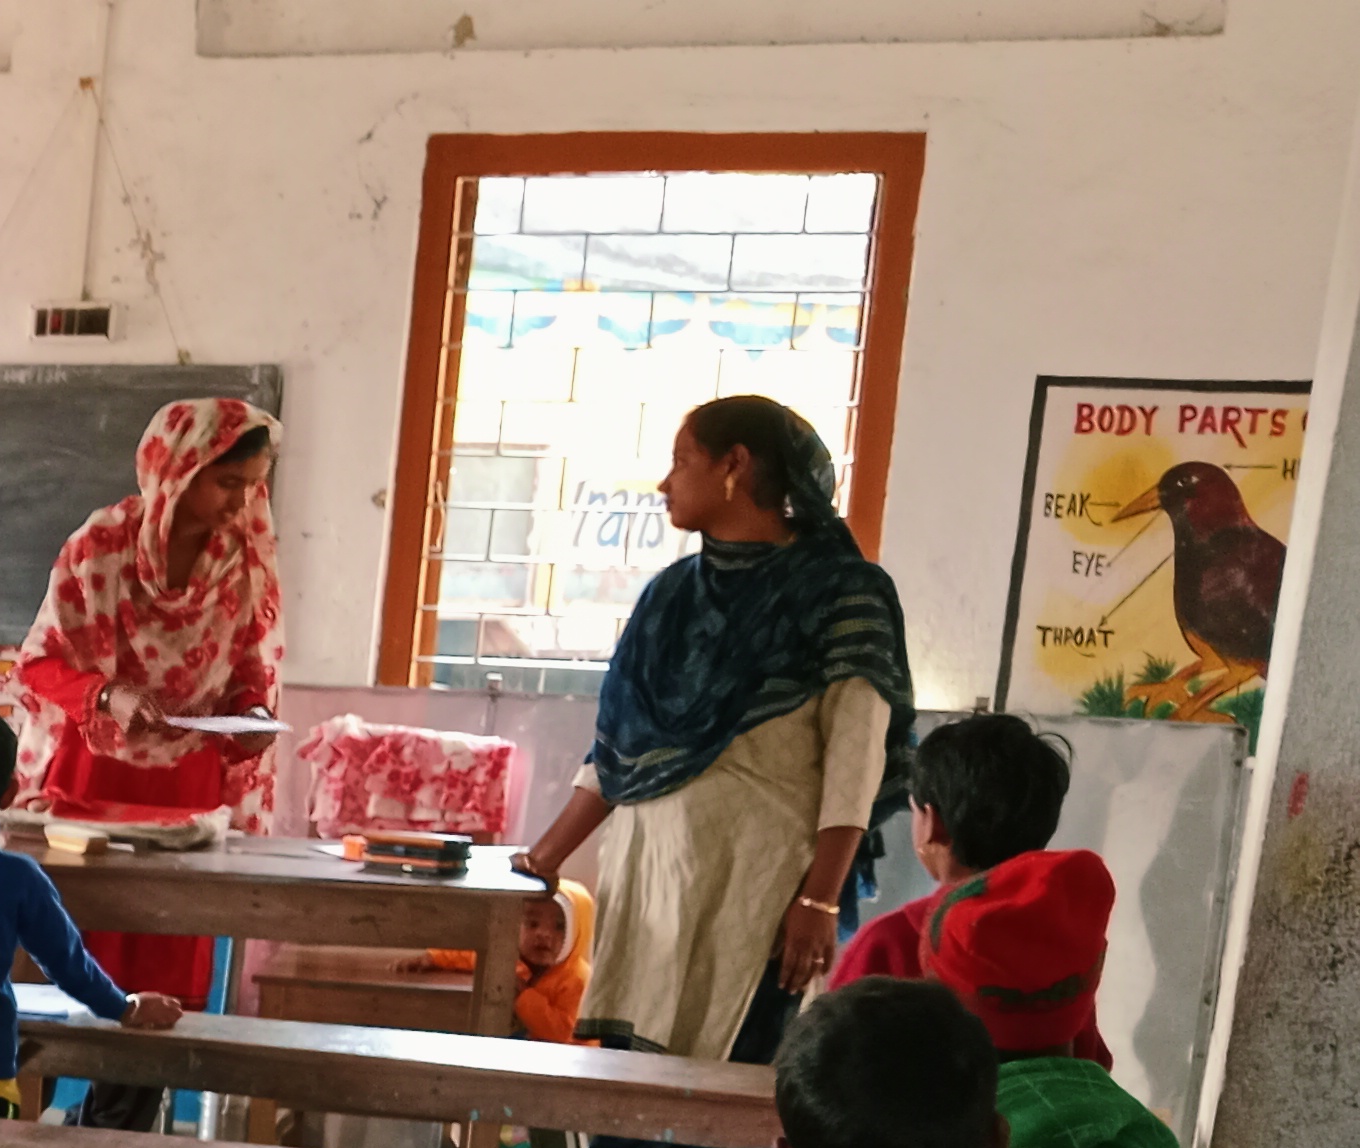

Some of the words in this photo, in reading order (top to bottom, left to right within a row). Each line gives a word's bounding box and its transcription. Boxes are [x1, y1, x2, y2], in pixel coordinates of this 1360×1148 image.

[1074, 403, 1159, 436] BODY
[1178, 404, 1288, 448] PARTS
[1044, 493, 1102, 526] BEAK
[1072, 551, 1108, 577] EYE
[1037, 625, 1115, 657] THROAT
